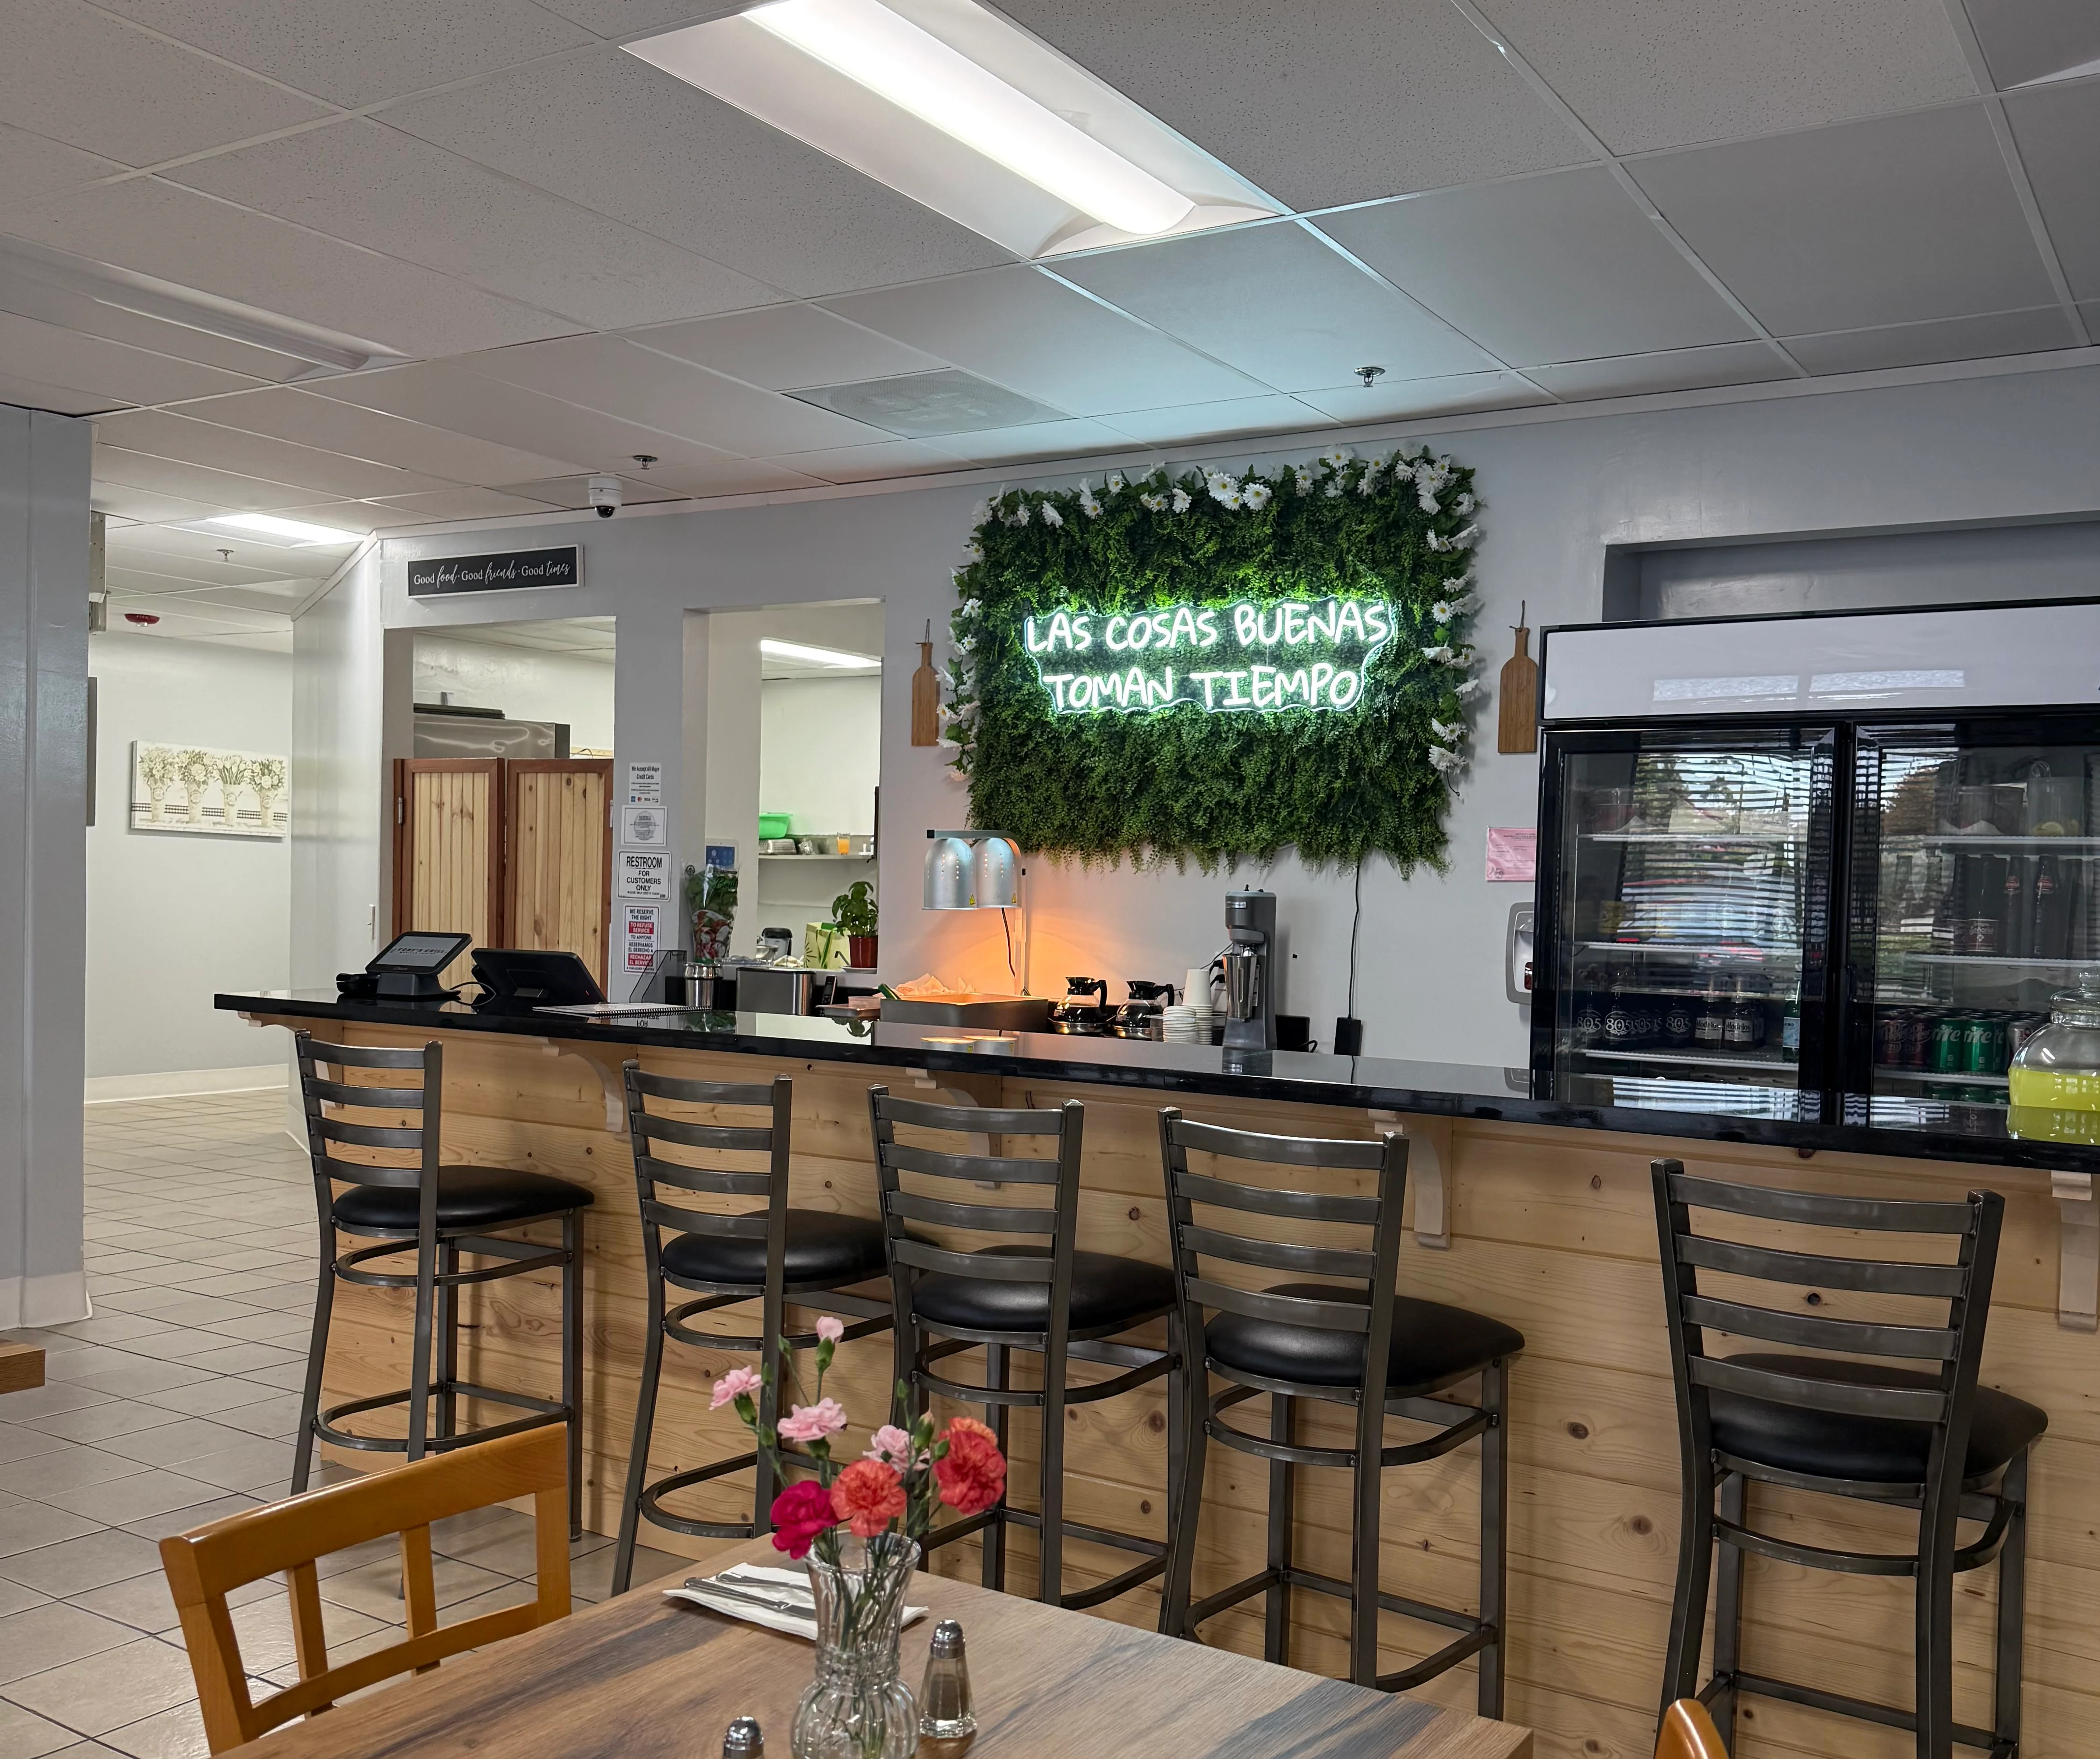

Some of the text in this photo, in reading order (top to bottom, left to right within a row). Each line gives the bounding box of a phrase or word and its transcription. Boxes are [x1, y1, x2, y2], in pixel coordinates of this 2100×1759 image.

[414, 560, 571, 588] Good food Good friends Good times
[1027, 600, 1389, 653] LAS COSAS BUENAS
[1043, 662, 1358, 708] TOMAN TIEMPO
[627, 856, 662, 868] RESTROOM
[1577, 1017, 1601, 1030] 805
[1606, 1018, 1631, 1032] 805
[1666, 1017, 1691, 1029] 805
[1932, 1024, 1961, 1042] rite
[1964, 1026, 1992, 1043] rite
